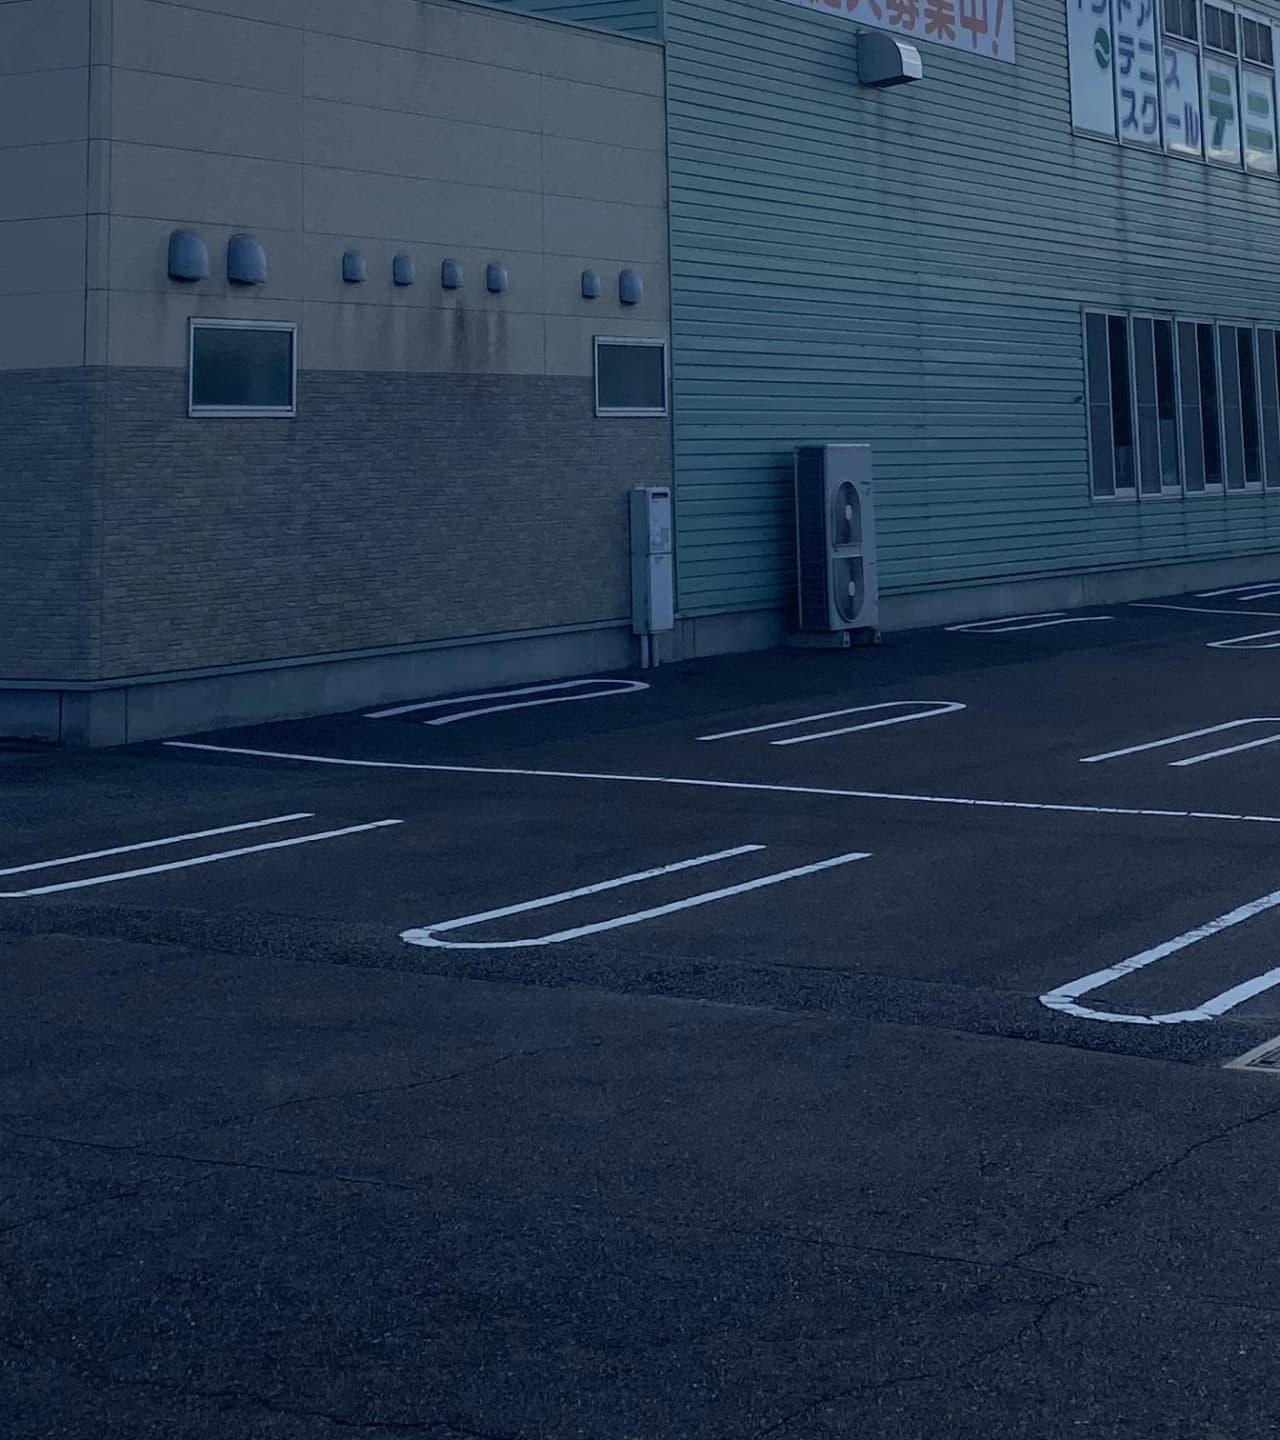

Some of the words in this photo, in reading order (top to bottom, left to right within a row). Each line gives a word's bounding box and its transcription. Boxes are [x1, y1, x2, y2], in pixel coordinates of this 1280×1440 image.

[1118, 34, 1181, 90] テニス
[1120, 89, 1200, 149] スクール
